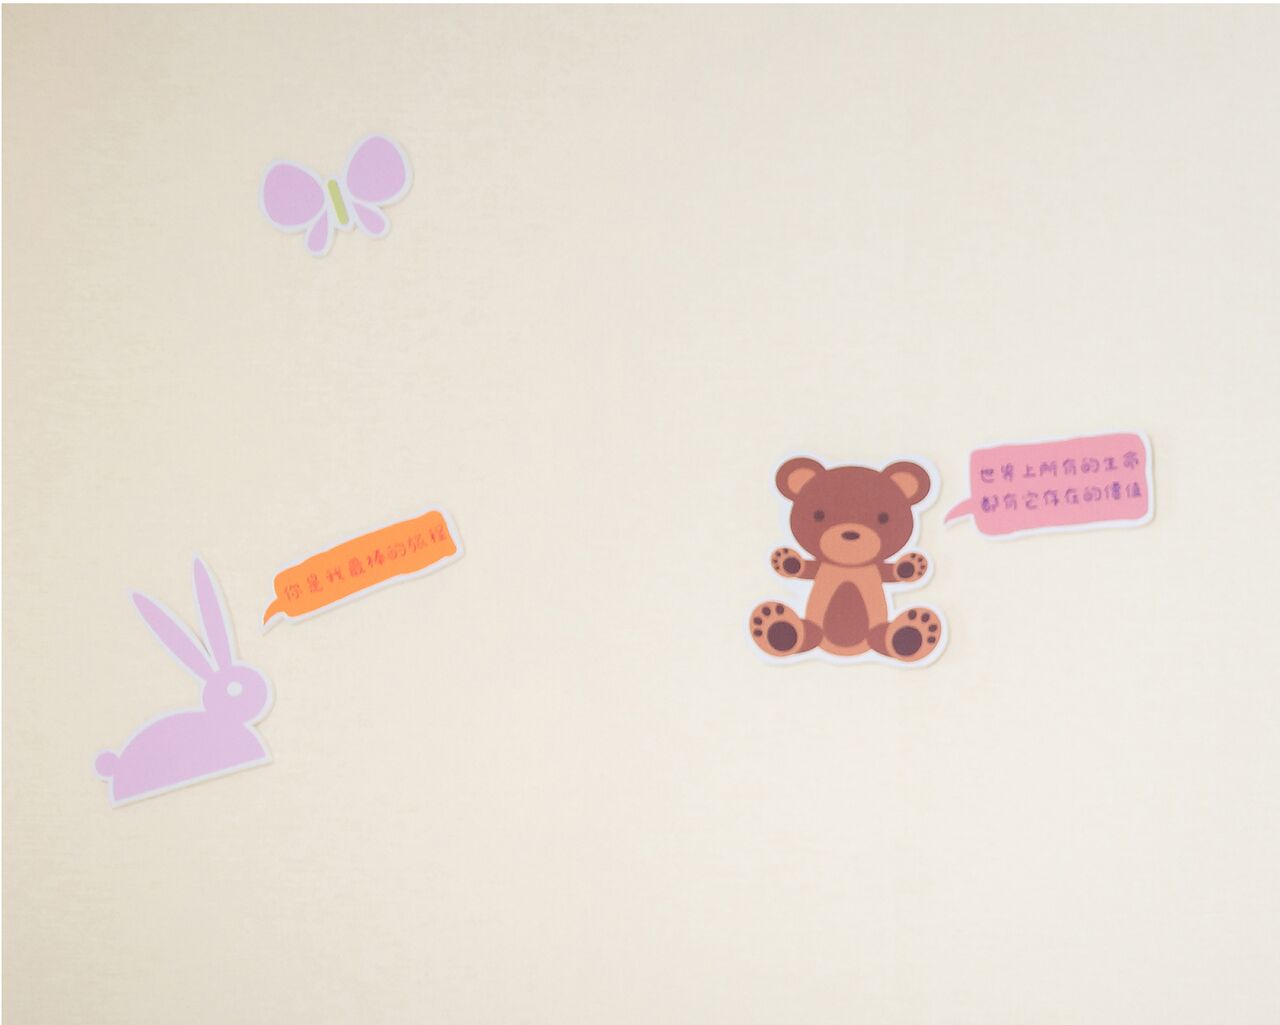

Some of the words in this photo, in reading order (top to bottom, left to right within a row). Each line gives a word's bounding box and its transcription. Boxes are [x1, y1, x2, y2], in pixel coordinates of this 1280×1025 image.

[980, 451, 1139, 483] 世界上所有的生命
[981, 481, 1141, 512] 都有它存在的價值
